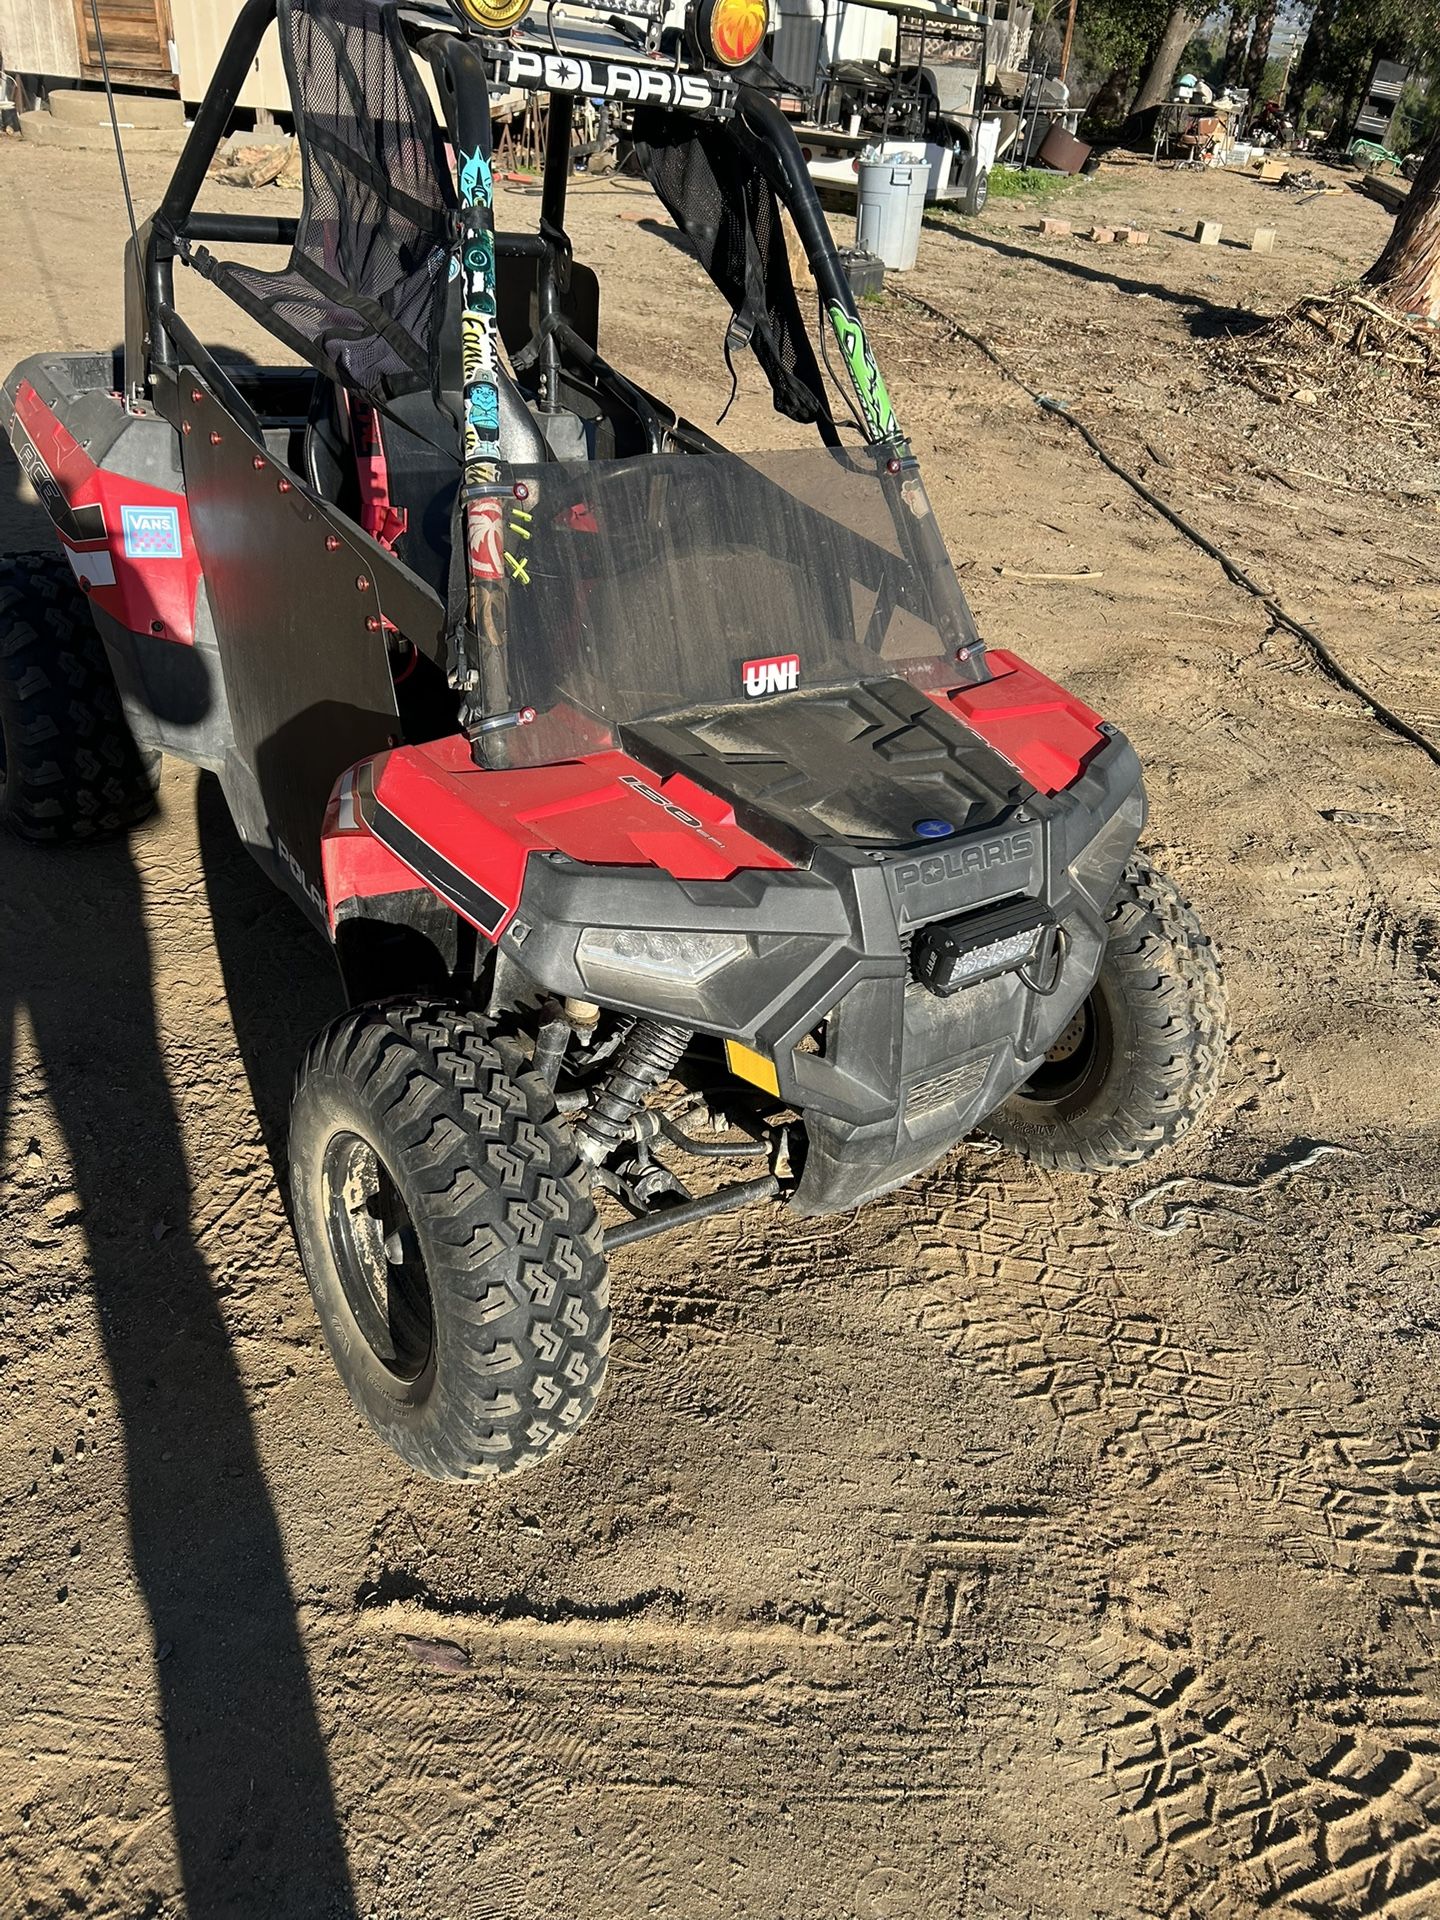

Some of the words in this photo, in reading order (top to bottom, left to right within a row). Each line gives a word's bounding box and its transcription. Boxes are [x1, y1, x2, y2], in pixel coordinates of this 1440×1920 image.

[507, 50, 713, 109] POLARIS
[18, 443, 61, 506] ACE
[129, 515, 173, 530] VANS
[746, 660, 798, 697] UNI
[618, 775, 703, 829] 150
[894, 831, 1034, 894] POLARIS
